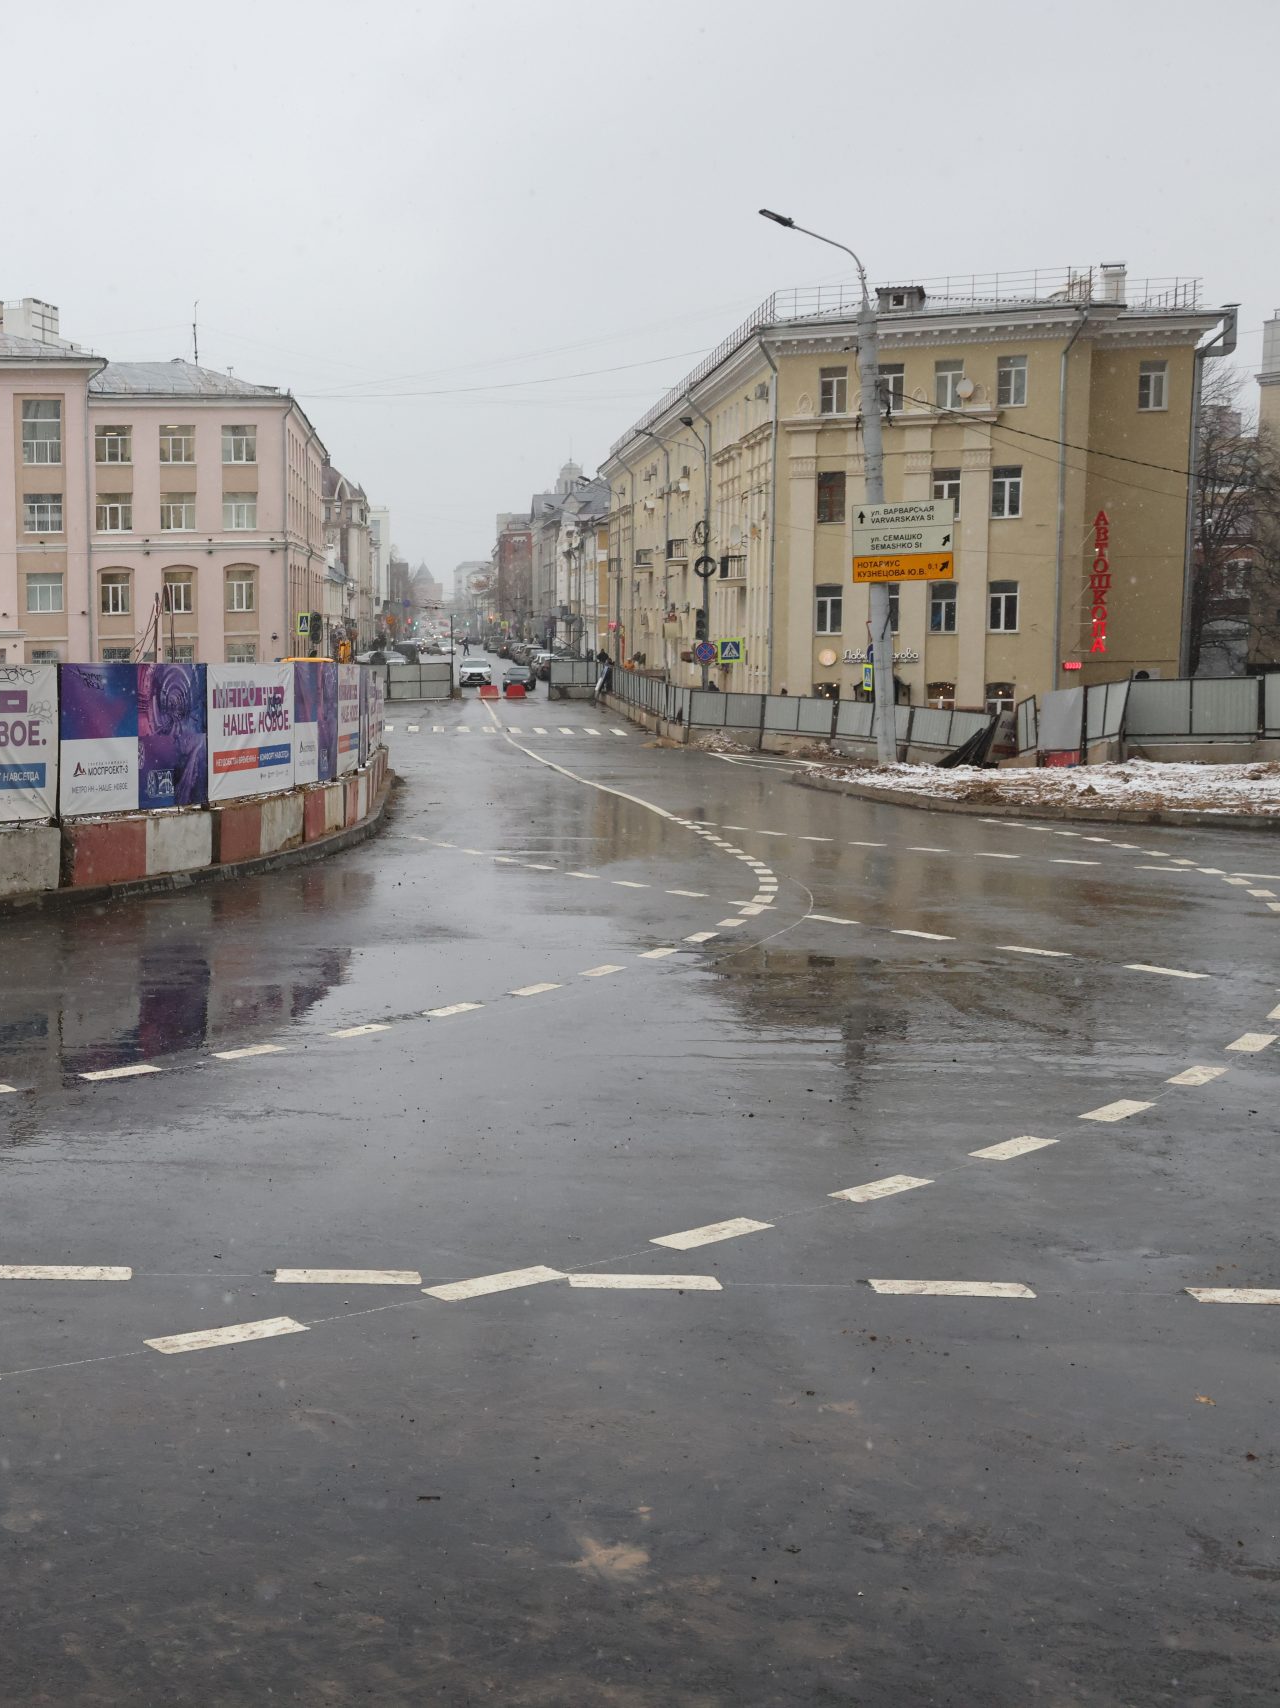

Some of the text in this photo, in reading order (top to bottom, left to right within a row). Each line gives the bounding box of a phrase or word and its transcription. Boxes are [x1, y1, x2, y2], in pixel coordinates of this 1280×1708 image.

[883, 505, 934, 515] ВАРВАРСКАЯ
[871, 515, 924, 524] VARVARSKAYA
[883, 533, 922, 542] СЕМАШКО
[871, 542, 912, 550] SEMASHKO
[857, 560, 900, 569] НОТАРИУС
[857, 569, 905, 578] КУЗНЕЦОВА
[1089, 510, 1111, 653] АВТОШКОЛА
[216, 680, 256, 708] МЕТРО
[3, 771, 40, 783] НАВСЕГДА
